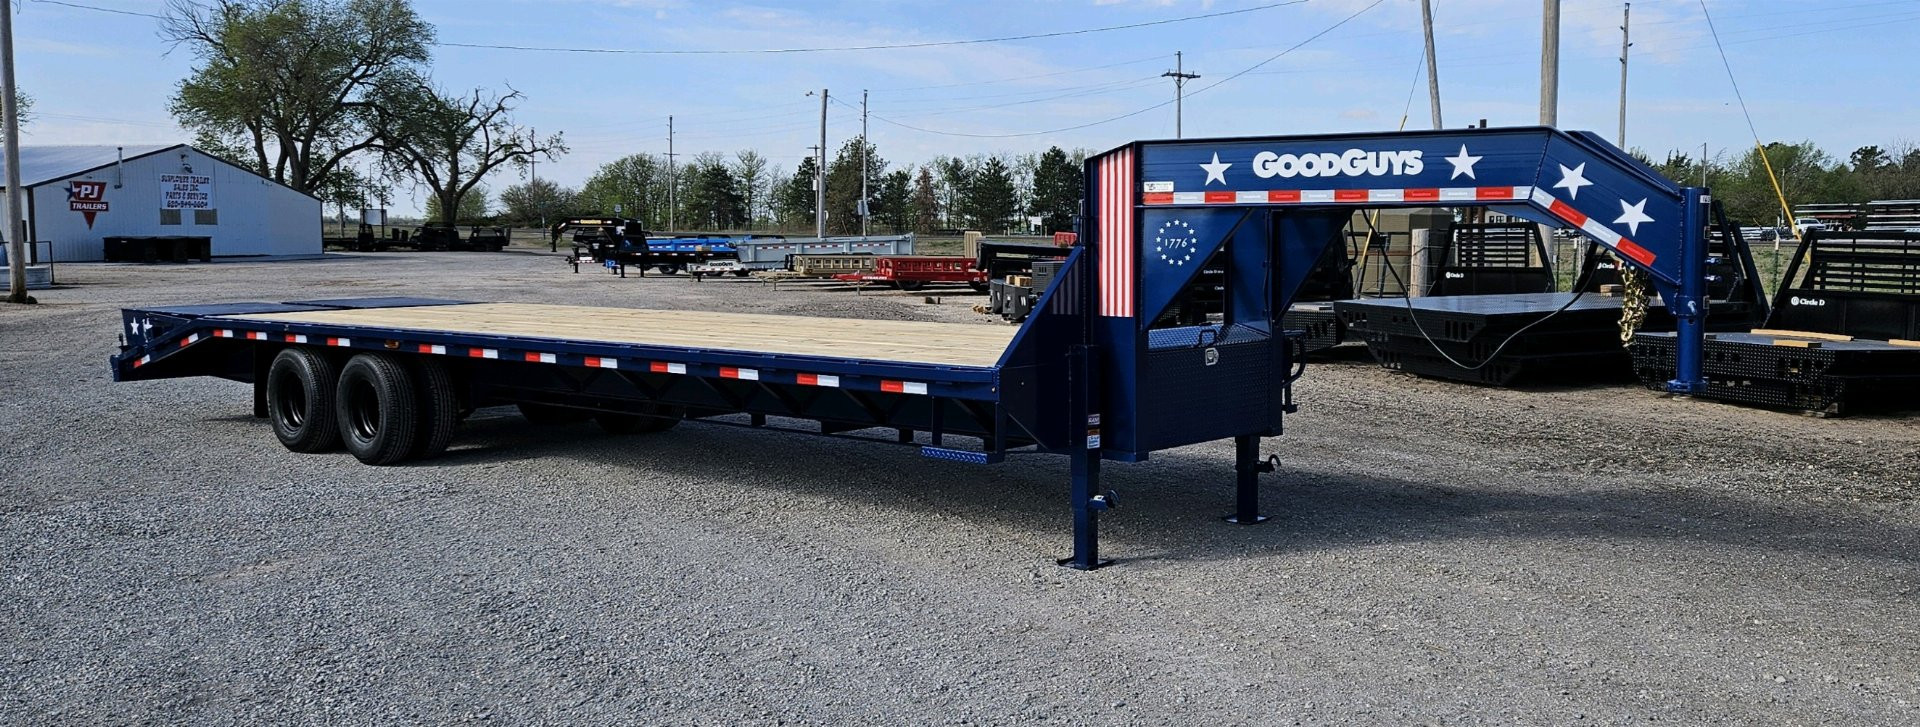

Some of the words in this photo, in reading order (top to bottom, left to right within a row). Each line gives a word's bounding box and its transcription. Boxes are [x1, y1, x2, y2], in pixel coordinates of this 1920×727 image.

[80, 184, 99, 198] PJ
[173, 183, 189, 191] SALES
[165, 191, 182, 200] PARTS
[187, 192, 208, 201] SERVICE
[72, 202, 107, 210] TRAILERS
[1165, 238, 1188, 249] 1776
